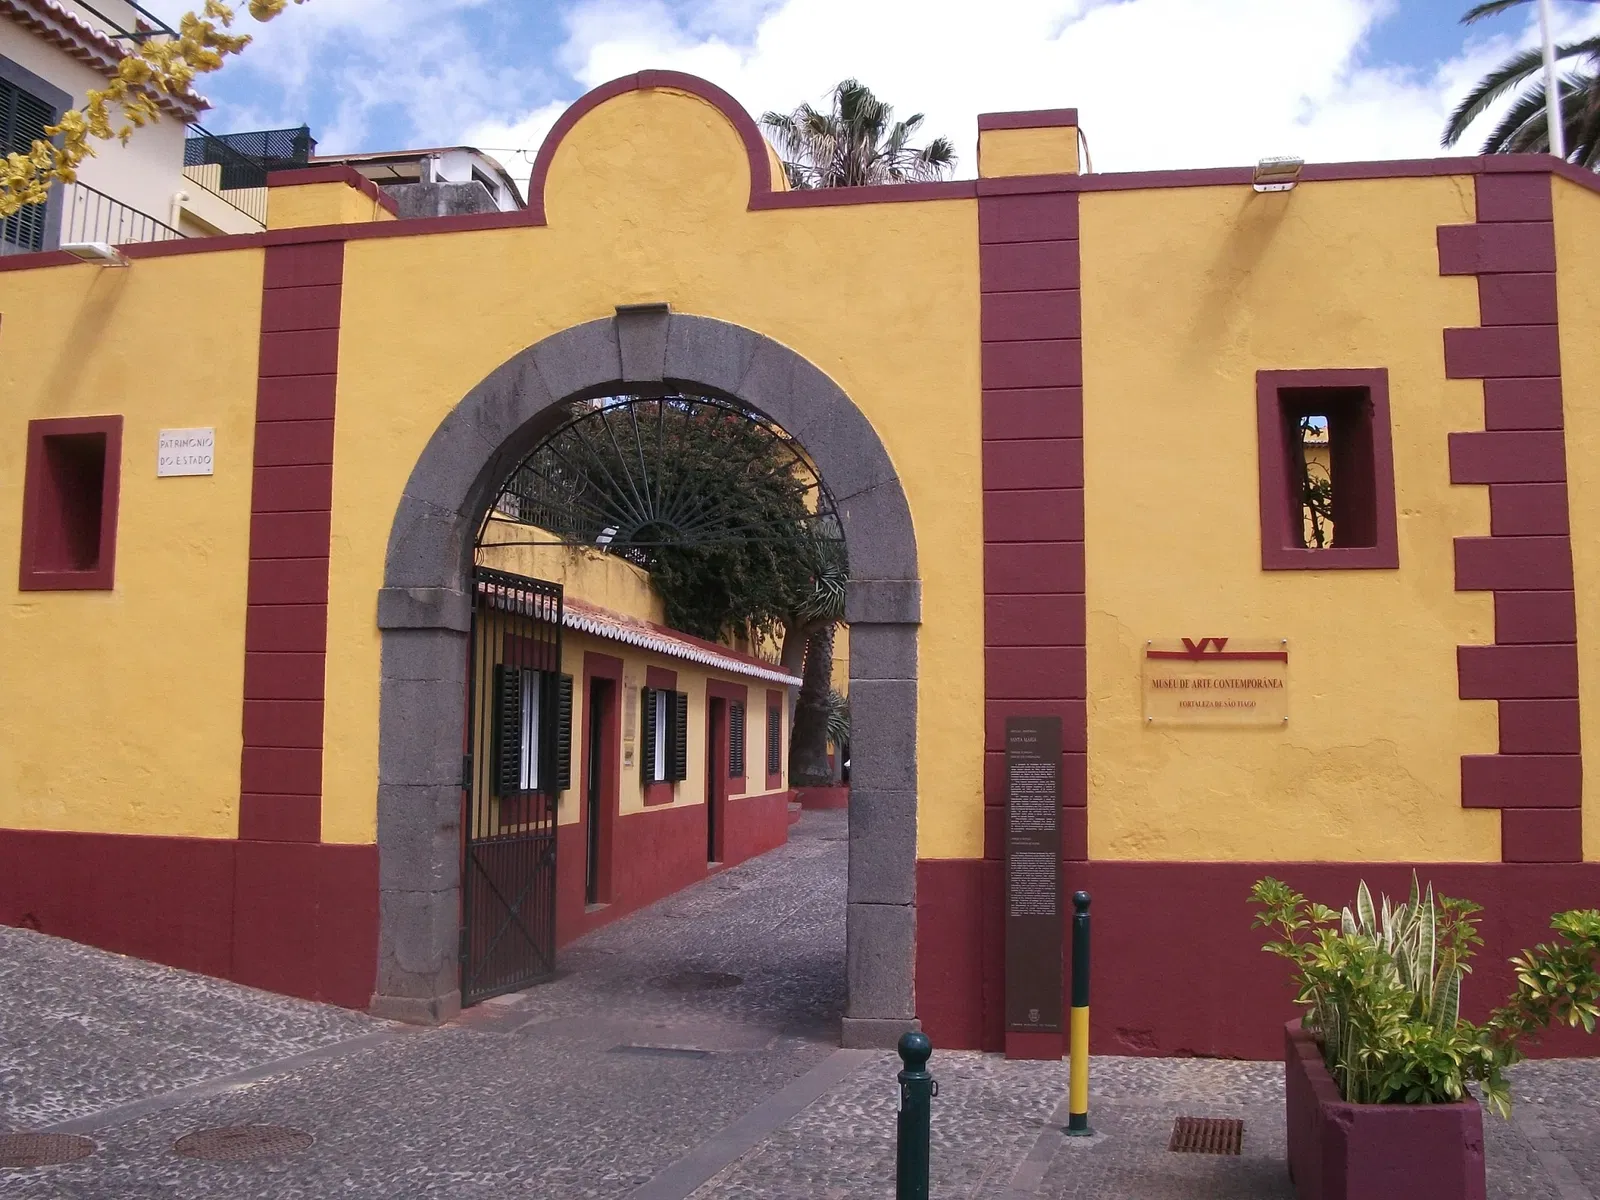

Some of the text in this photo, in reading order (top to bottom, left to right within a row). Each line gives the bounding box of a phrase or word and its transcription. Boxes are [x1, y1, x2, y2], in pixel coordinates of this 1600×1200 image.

[160, 455, 211, 466] DO ESTADO
[1152, 677, 1284, 689] MUSEU DE ARTE CONTEMPORÂNEA
[1179, 700, 1214, 708] FORTALEZA
[1224, 698, 1236, 708] SÃO
